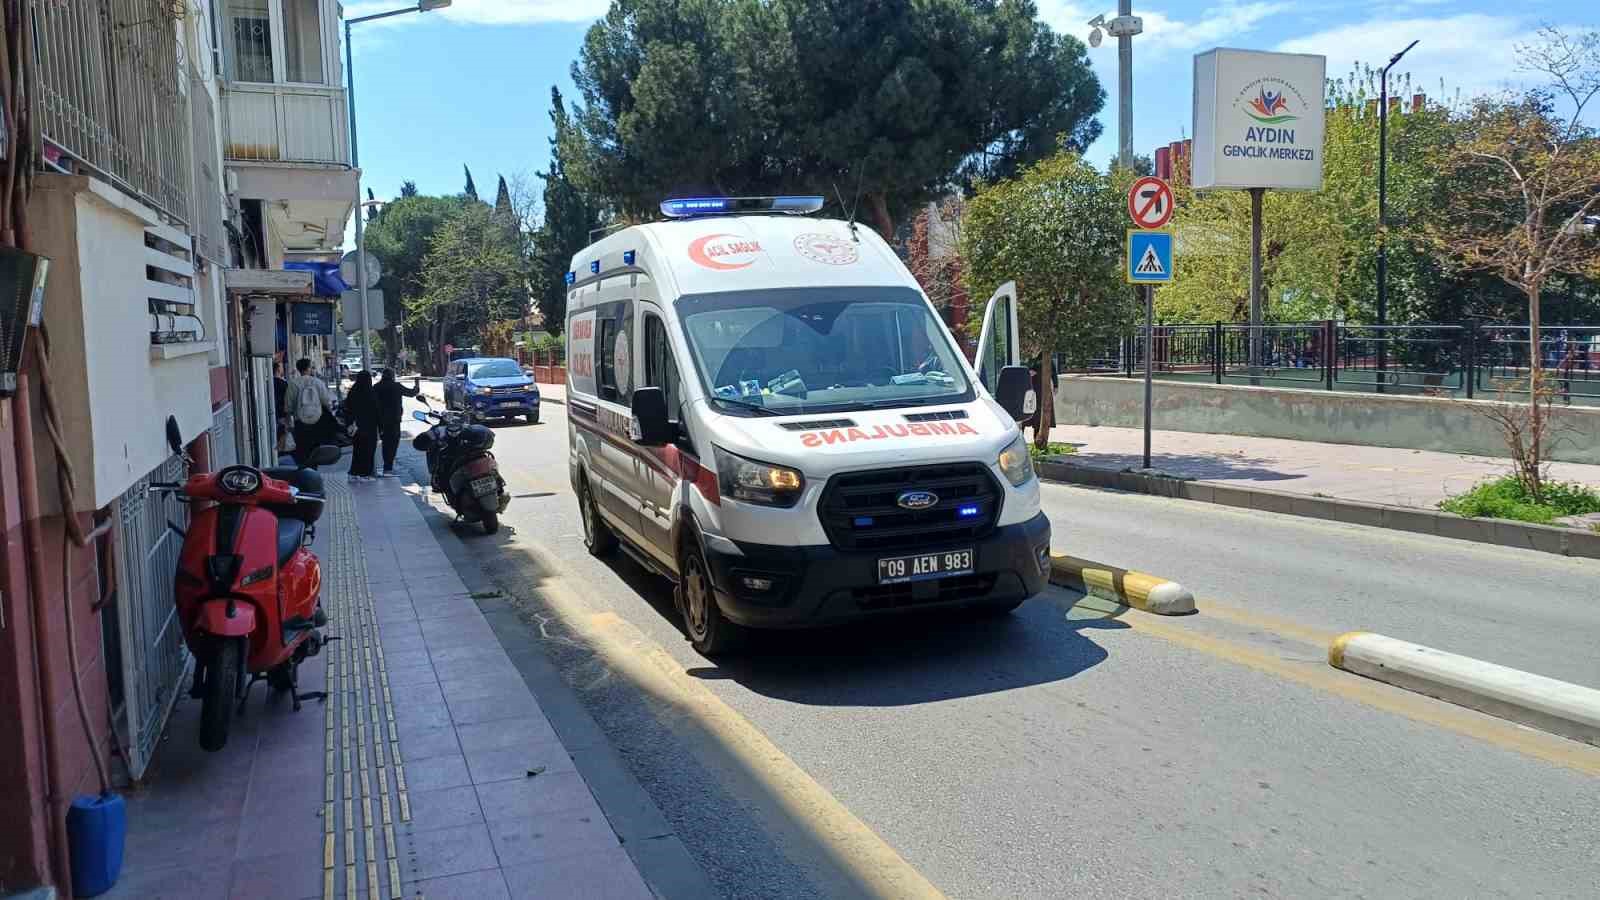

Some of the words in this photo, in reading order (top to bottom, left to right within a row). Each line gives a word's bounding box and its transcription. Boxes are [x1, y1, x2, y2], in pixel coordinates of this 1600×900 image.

[1245, 126, 1295, 144] AYDIN
[888, 559, 905, 577] 09
[913, 556, 938, 574] AEN
[944, 552, 970, 570] 983
